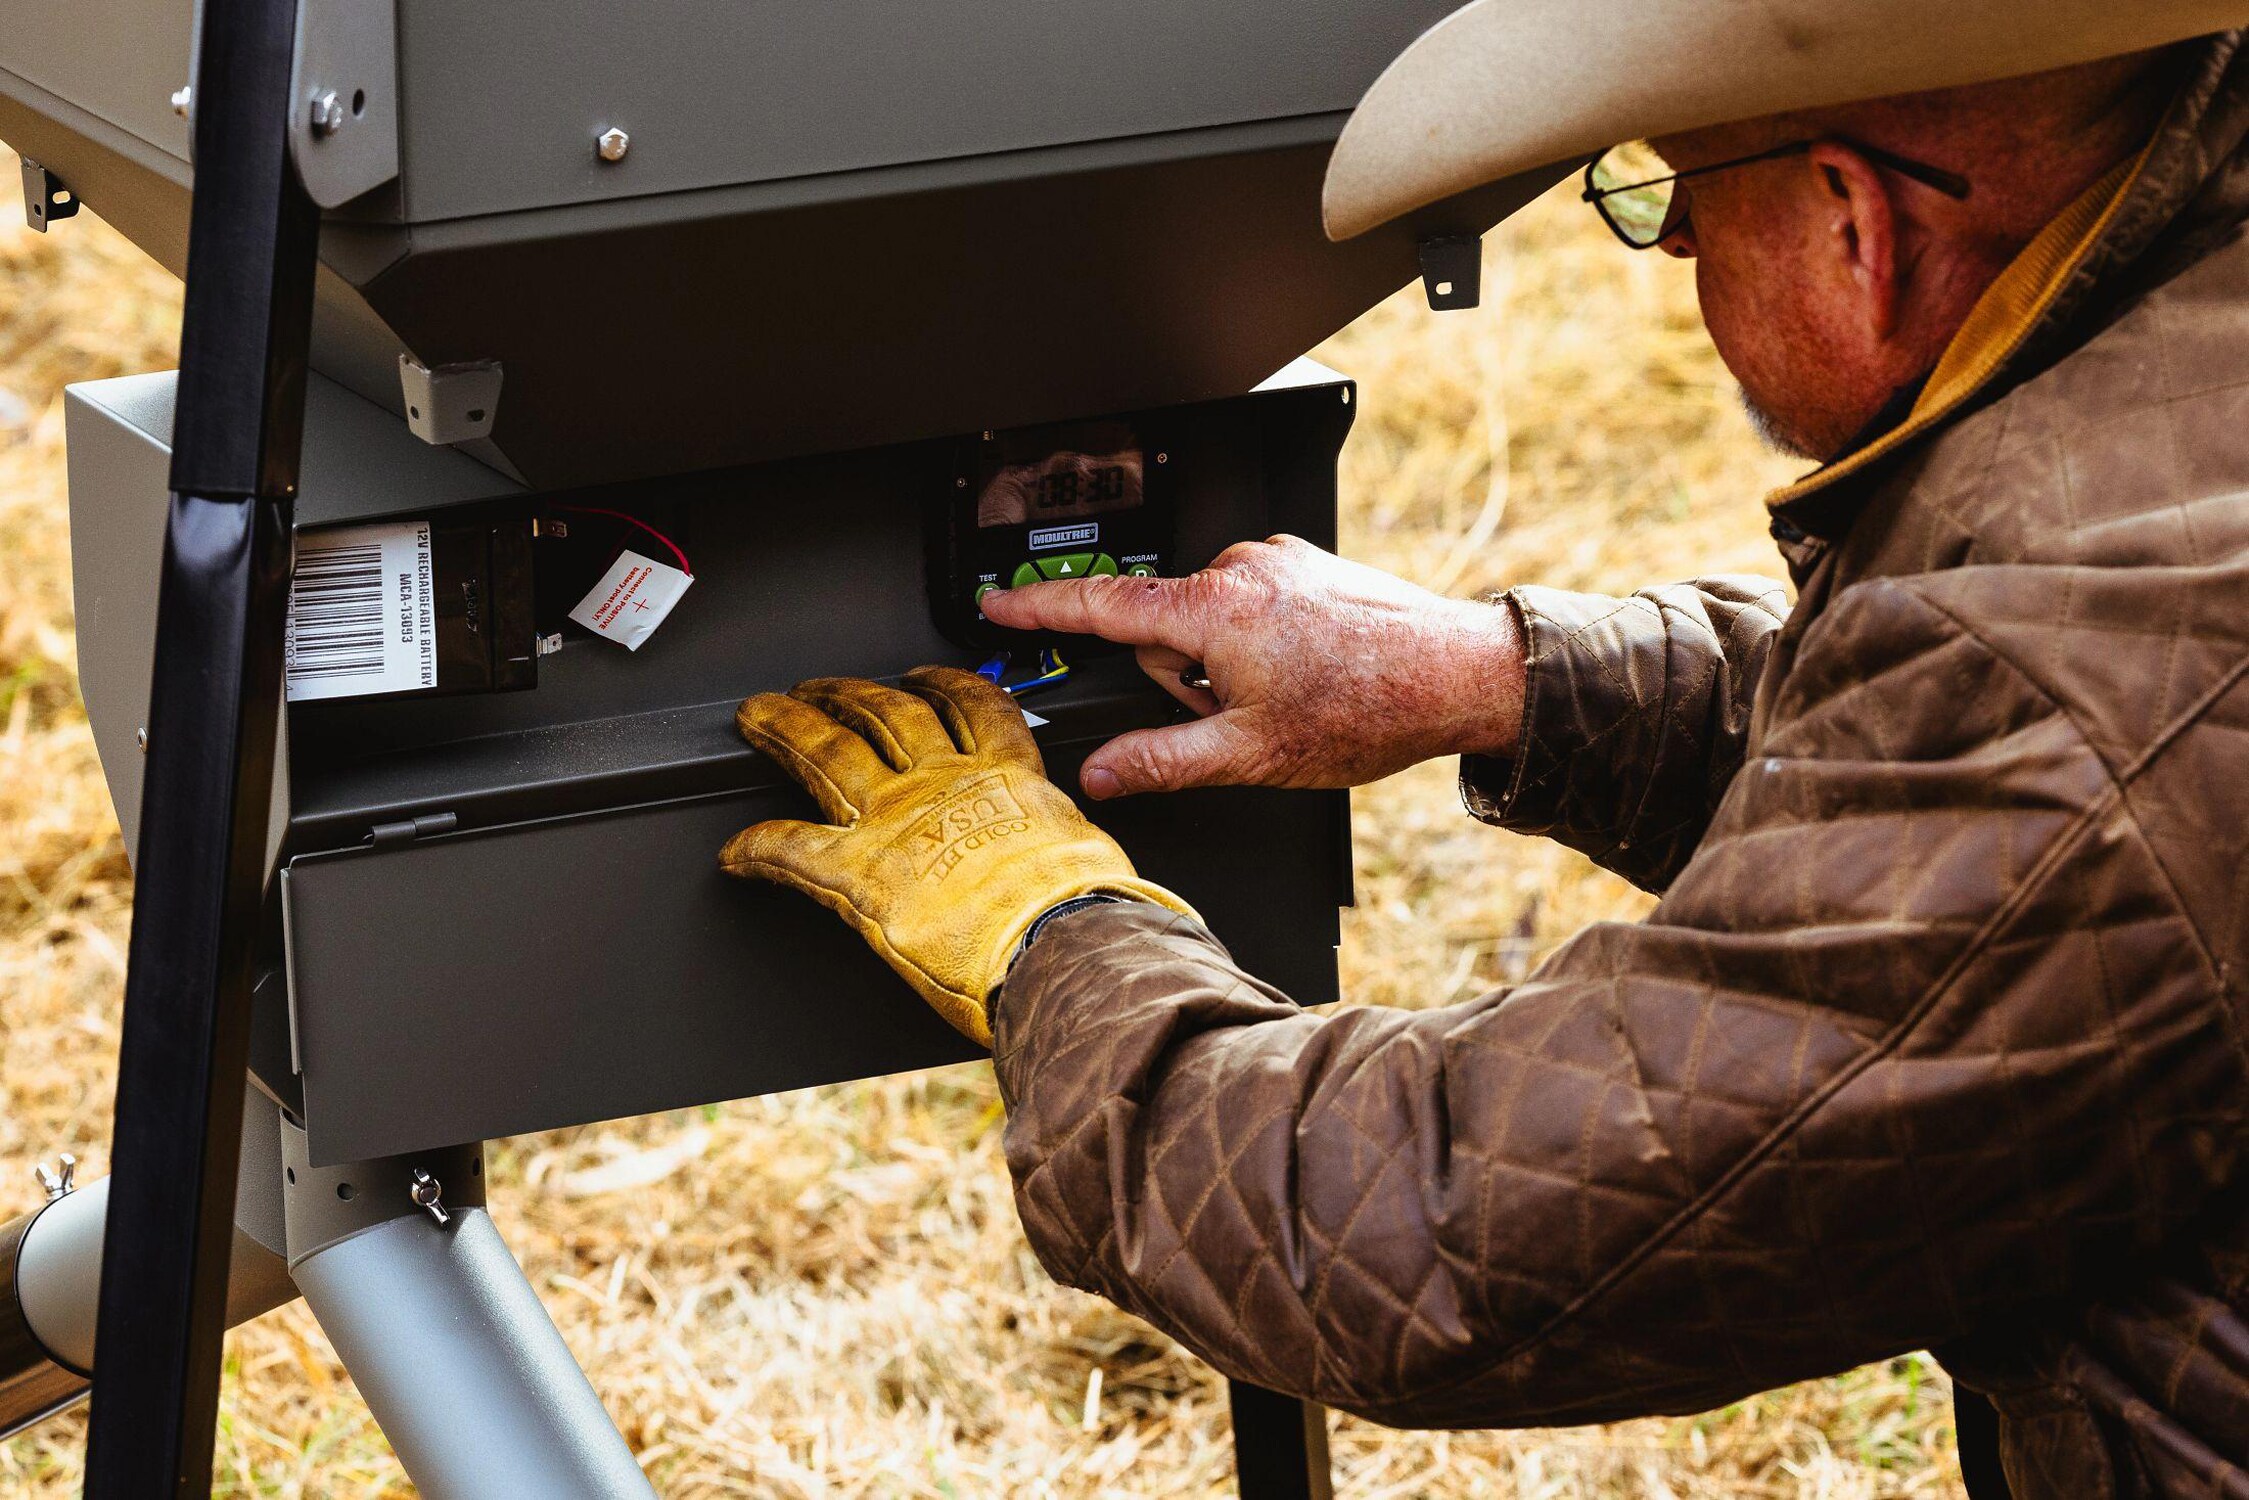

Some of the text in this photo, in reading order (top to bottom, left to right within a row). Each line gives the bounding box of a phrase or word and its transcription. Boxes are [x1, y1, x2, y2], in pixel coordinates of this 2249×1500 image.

[978, 573, 998, 583] TEST
[1121, 553, 1158, 564] PROGRAM
[400, 573, 413, 644] MCA-13093
[417, 527, 432, 686] 12V RECHARGEABLE BATTERY
[592, 567, 640, 621] battery post ONLY!
[598, 567, 652, 630] Connect to POSITIVE
[920, 798, 1003, 843] USA
